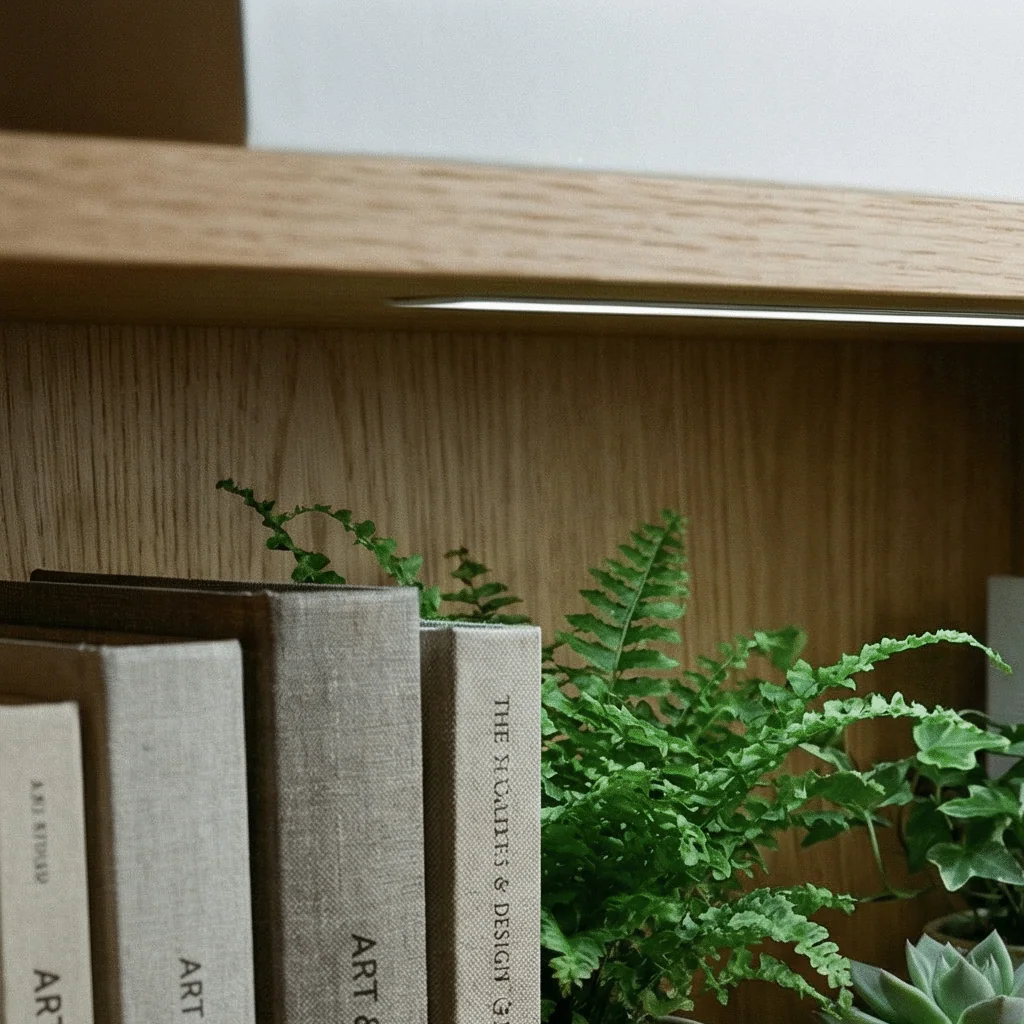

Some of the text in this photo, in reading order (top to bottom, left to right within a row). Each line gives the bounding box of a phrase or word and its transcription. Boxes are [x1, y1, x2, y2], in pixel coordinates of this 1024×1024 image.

[492, 694, 511, 743] THE
[493, 876, 510, 893] &
[351, 933, 379, 1003] ART
[493, 902, 511, 983] DESIGN
[179, 957, 204, 1016] ART
